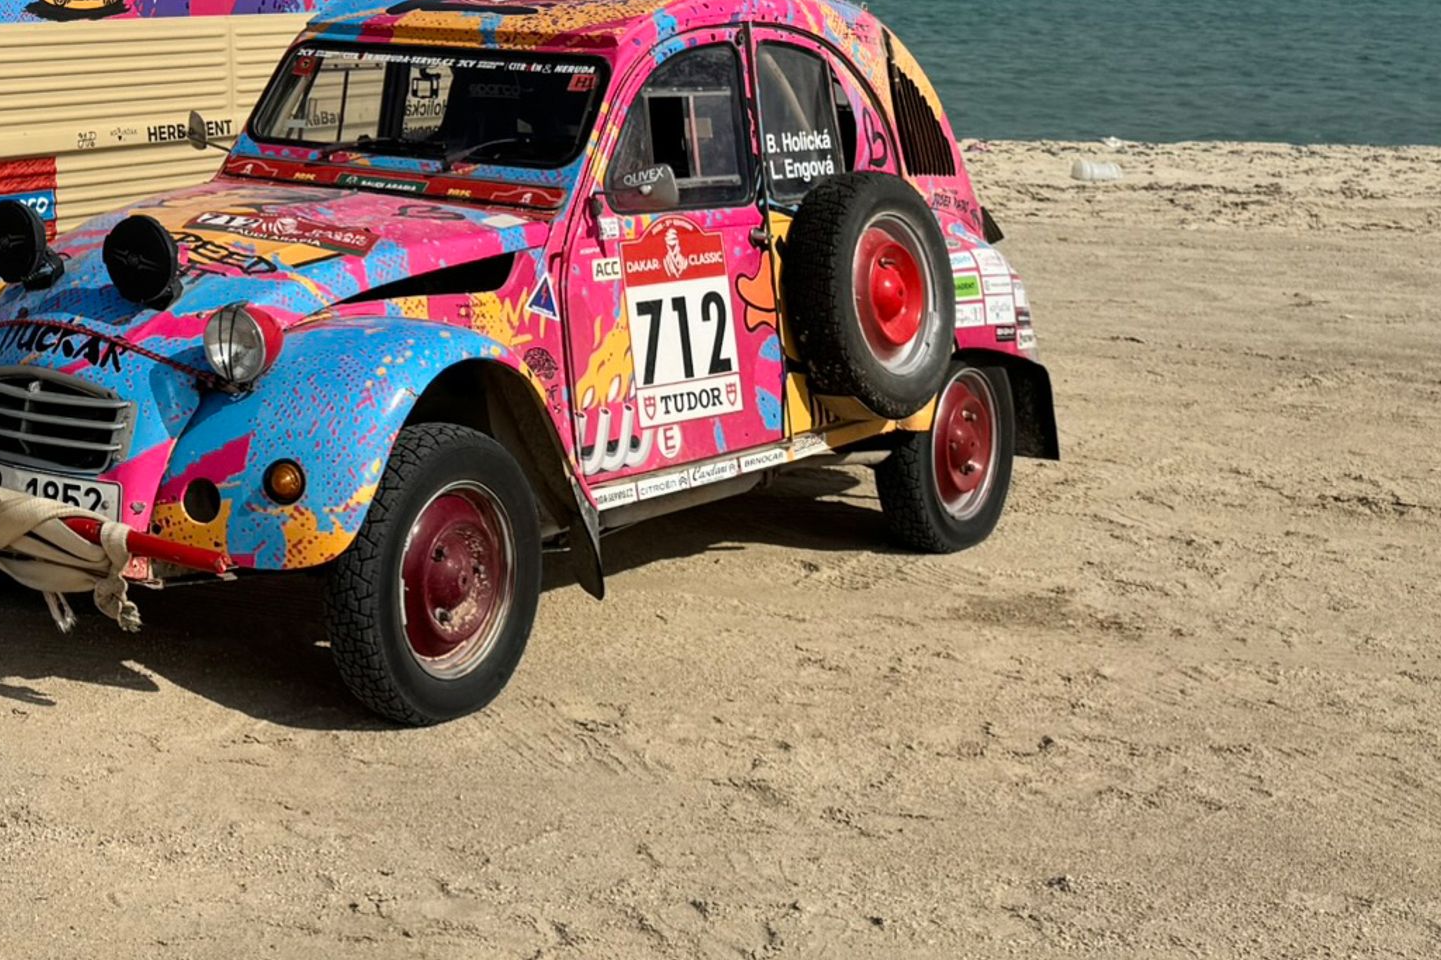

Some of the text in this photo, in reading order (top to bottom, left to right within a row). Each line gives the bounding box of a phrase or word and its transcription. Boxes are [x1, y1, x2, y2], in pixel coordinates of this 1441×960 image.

[554, 65, 596, 74] NERUDA
[147, 120, 232, 142] HERBENT
[766, 128, 831, 153] B. Holická
[624, 167, 664, 185] OLIVEX
[784, 155, 834, 182] Engová
[595, 261, 619, 277] ACC
[626, 251, 723, 273] DAKAR CLASSIC
[636, 291, 732, 385] 712
[660, 387, 723, 415] TUDOR
[663, 426, 676, 451] E
[744, 451, 784, 468] BRNOCAR
